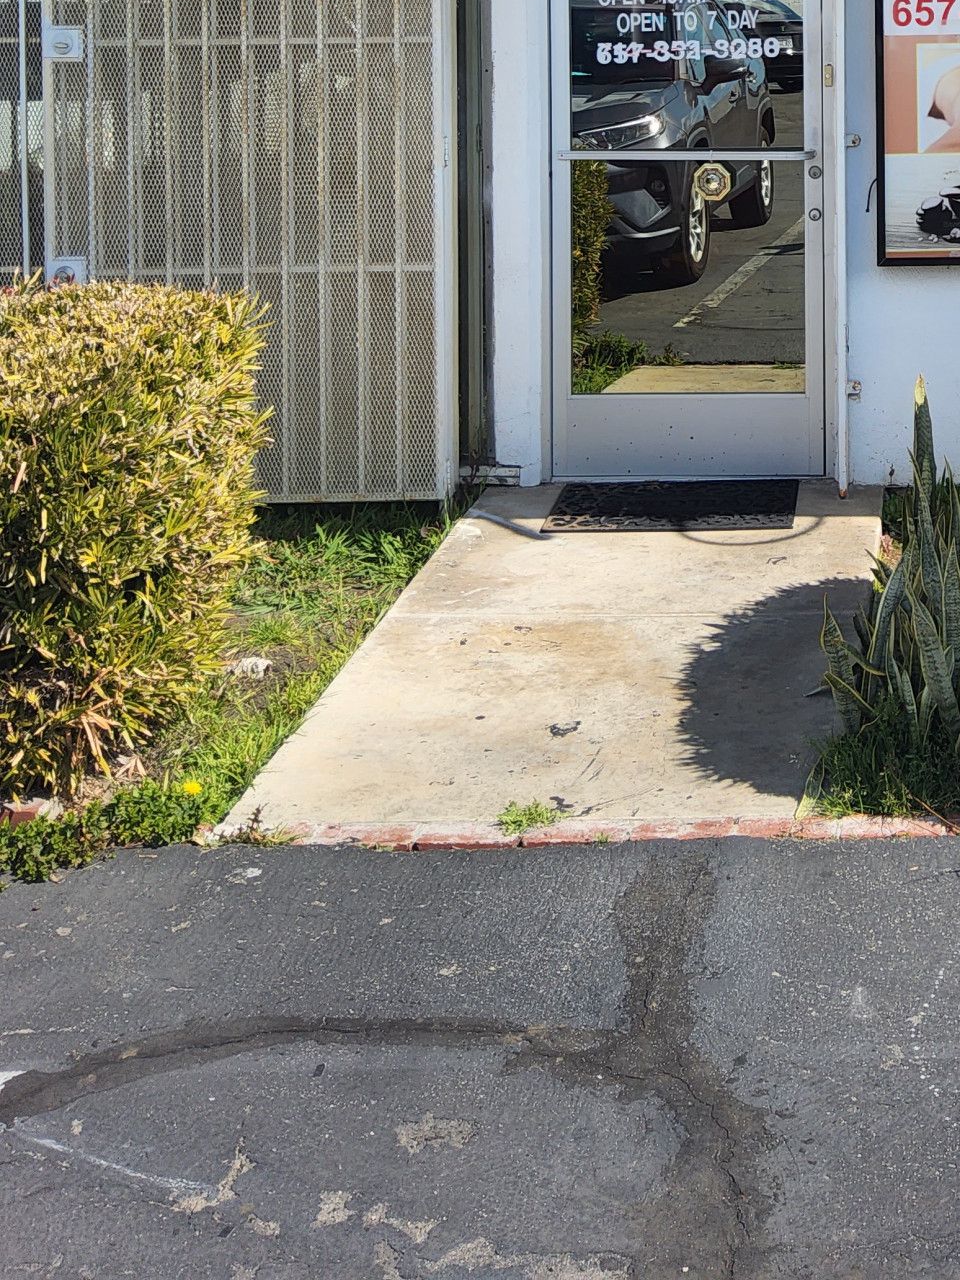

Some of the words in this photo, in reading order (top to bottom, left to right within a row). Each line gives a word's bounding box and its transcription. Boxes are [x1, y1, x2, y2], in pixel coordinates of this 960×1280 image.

[616, 13, 664, 33] OPEN
[673, 10, 697, 31] TO
[707, 11, 717, 30] 7
[727, 10, 759, 30] DAY
